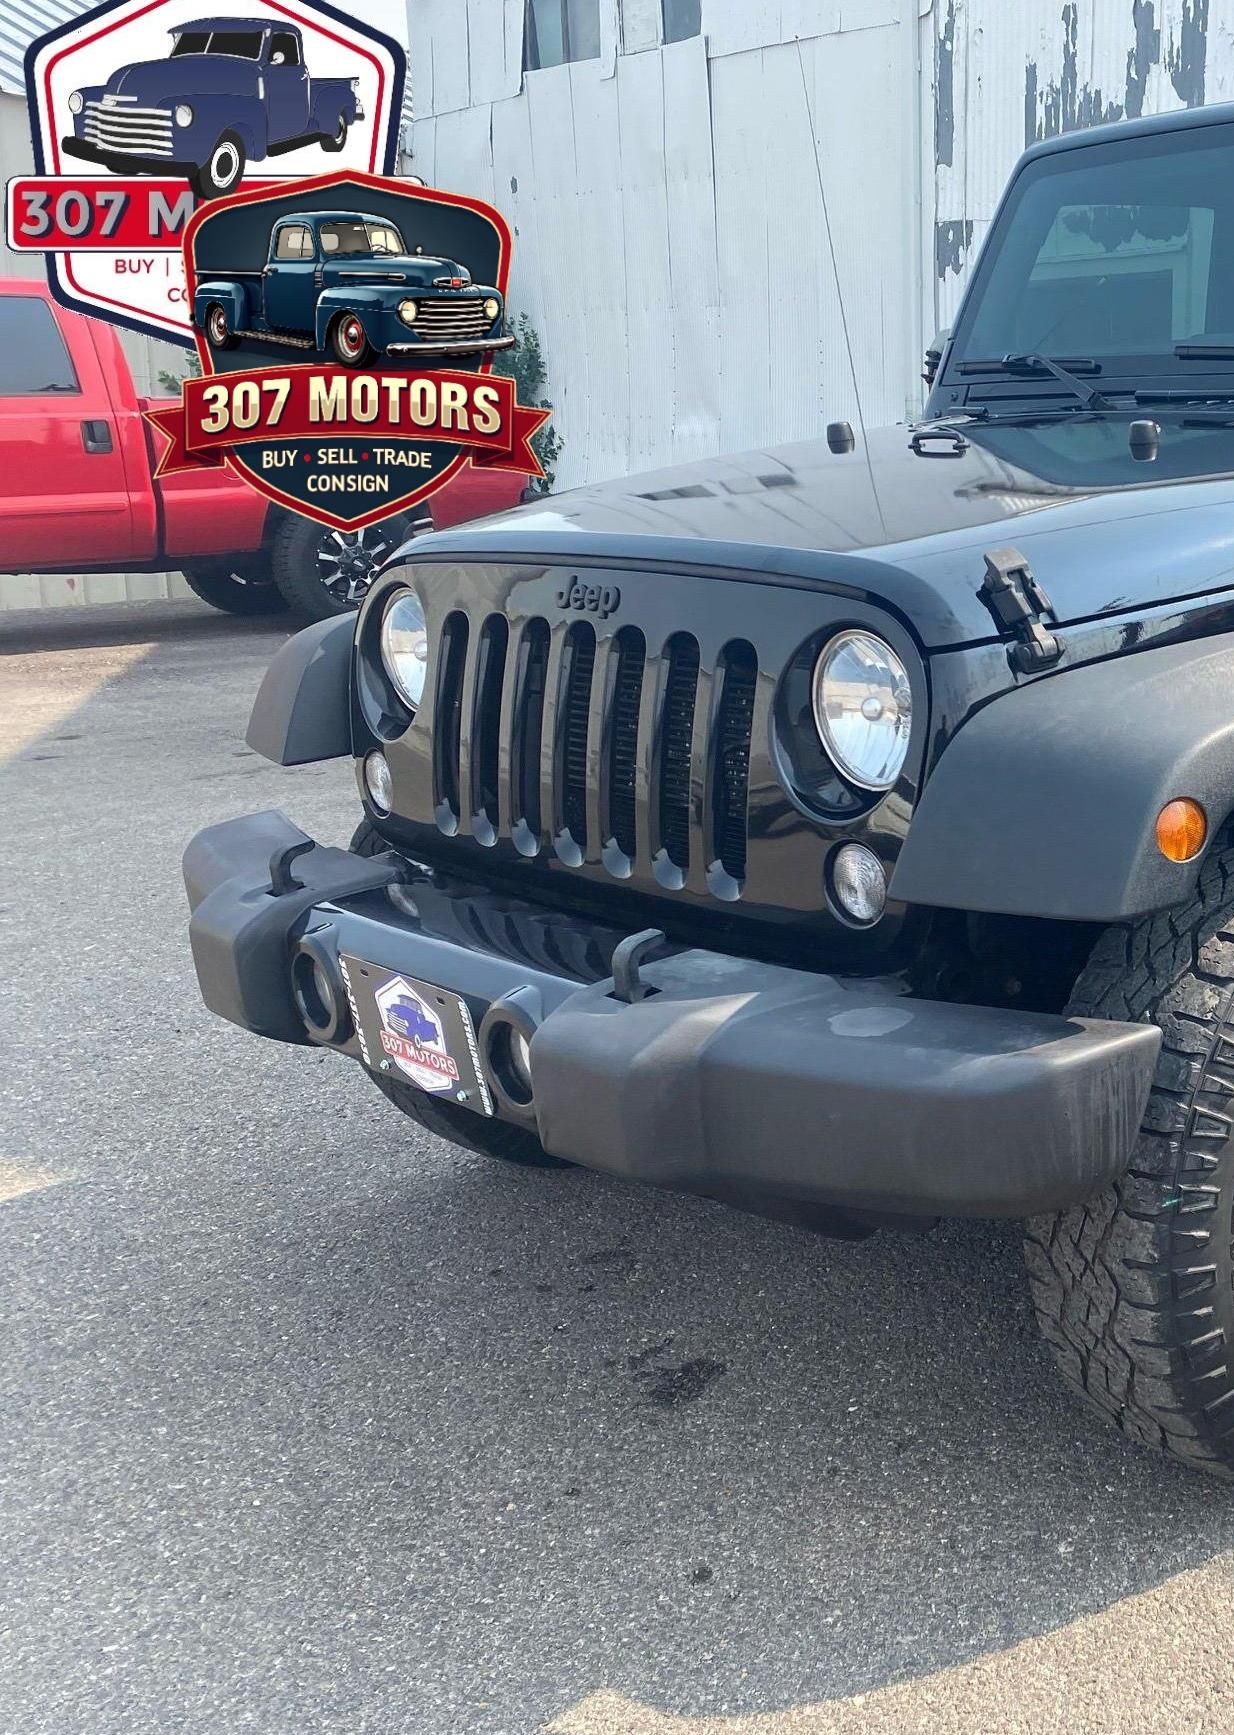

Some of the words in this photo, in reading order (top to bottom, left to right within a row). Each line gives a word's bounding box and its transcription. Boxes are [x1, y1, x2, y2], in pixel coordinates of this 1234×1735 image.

[555, 574, 622, 620] Jeep
[383, 1034, 403, 1054] 307
[404, 1044, 456, 1075] MOTORS
